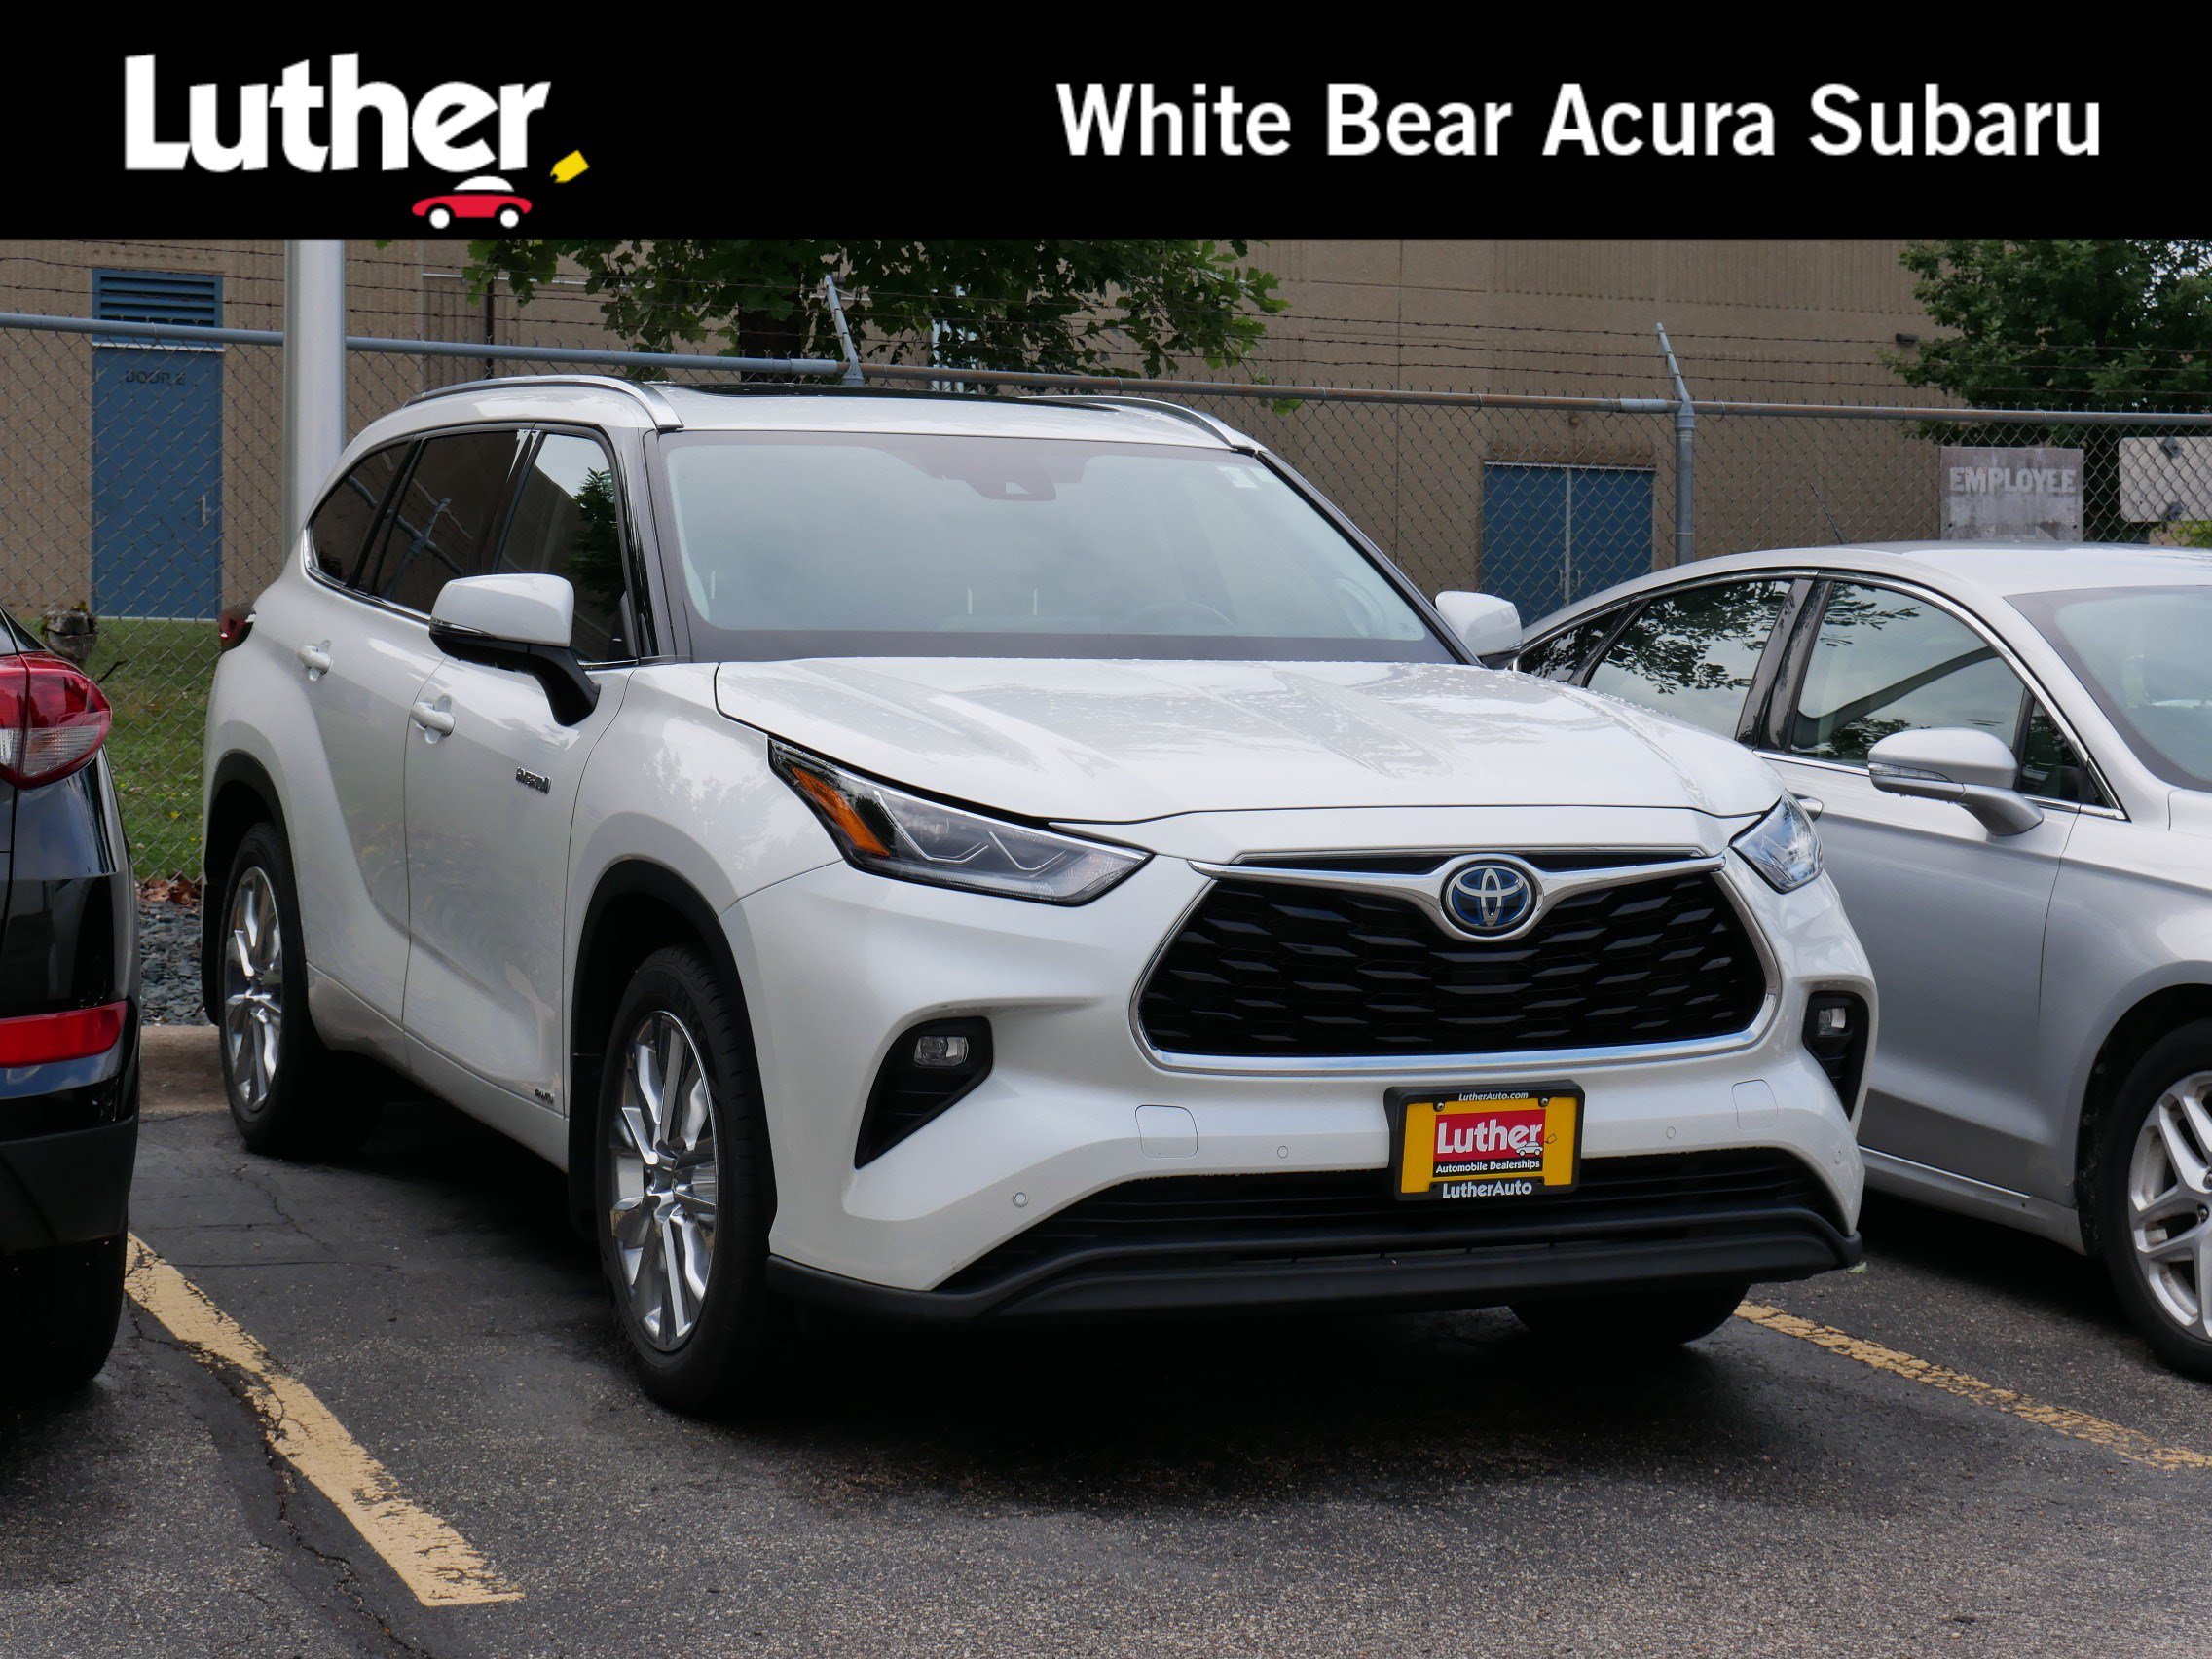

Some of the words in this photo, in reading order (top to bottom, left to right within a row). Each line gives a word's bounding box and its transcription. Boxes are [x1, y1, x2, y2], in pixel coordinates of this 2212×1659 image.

[1949, 467, 2077, 493] EMPLOYEE
[1458, 1091, 1529, 1102] LutherAuto.com
[1437, 1119, 1543, 1155] Luther
[1435, 1161, 1488, 1174] Automobile
[1490, 1159, 1540, 1171] Dealerships
[1442, 1179, 1532, 1198] LutherAuto
